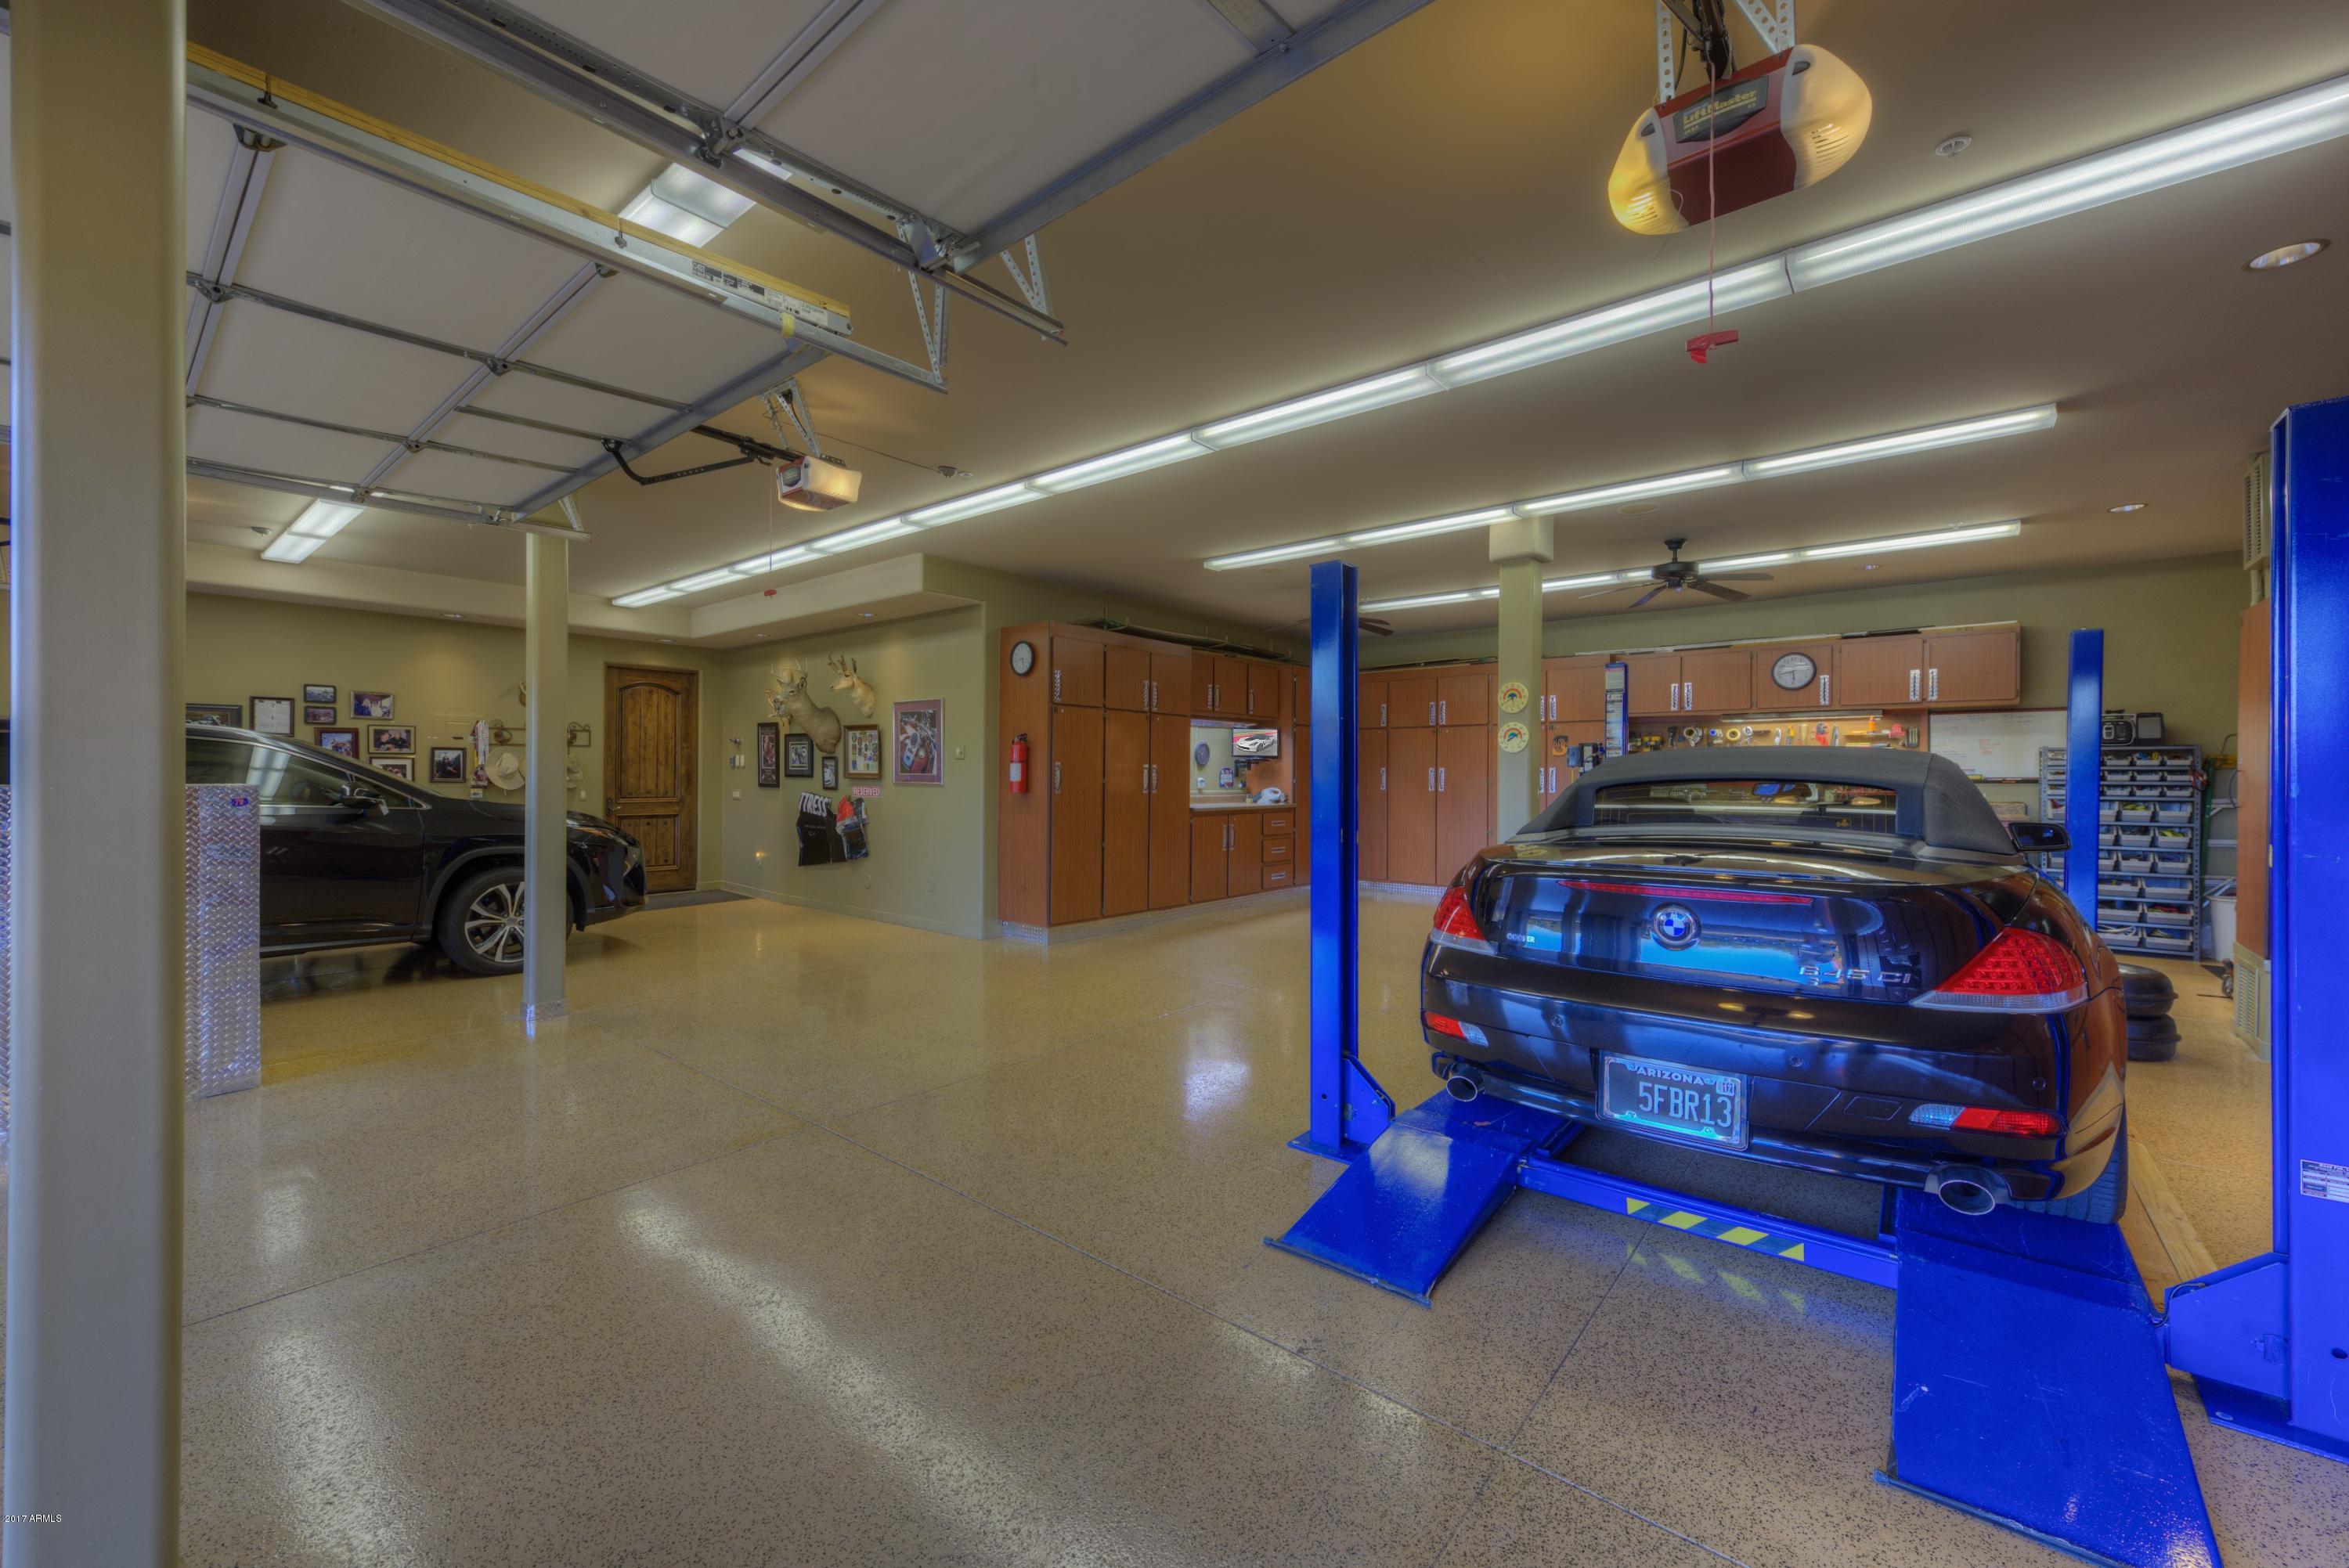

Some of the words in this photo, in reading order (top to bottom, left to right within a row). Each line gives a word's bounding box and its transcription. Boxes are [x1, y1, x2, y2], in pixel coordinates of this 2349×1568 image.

[853, 787, 879, 796] RESERVED
[1636, 1066, 1705, 1086] ARIZONA
[1639, 1081, 1732, 1127] 5FBR13
